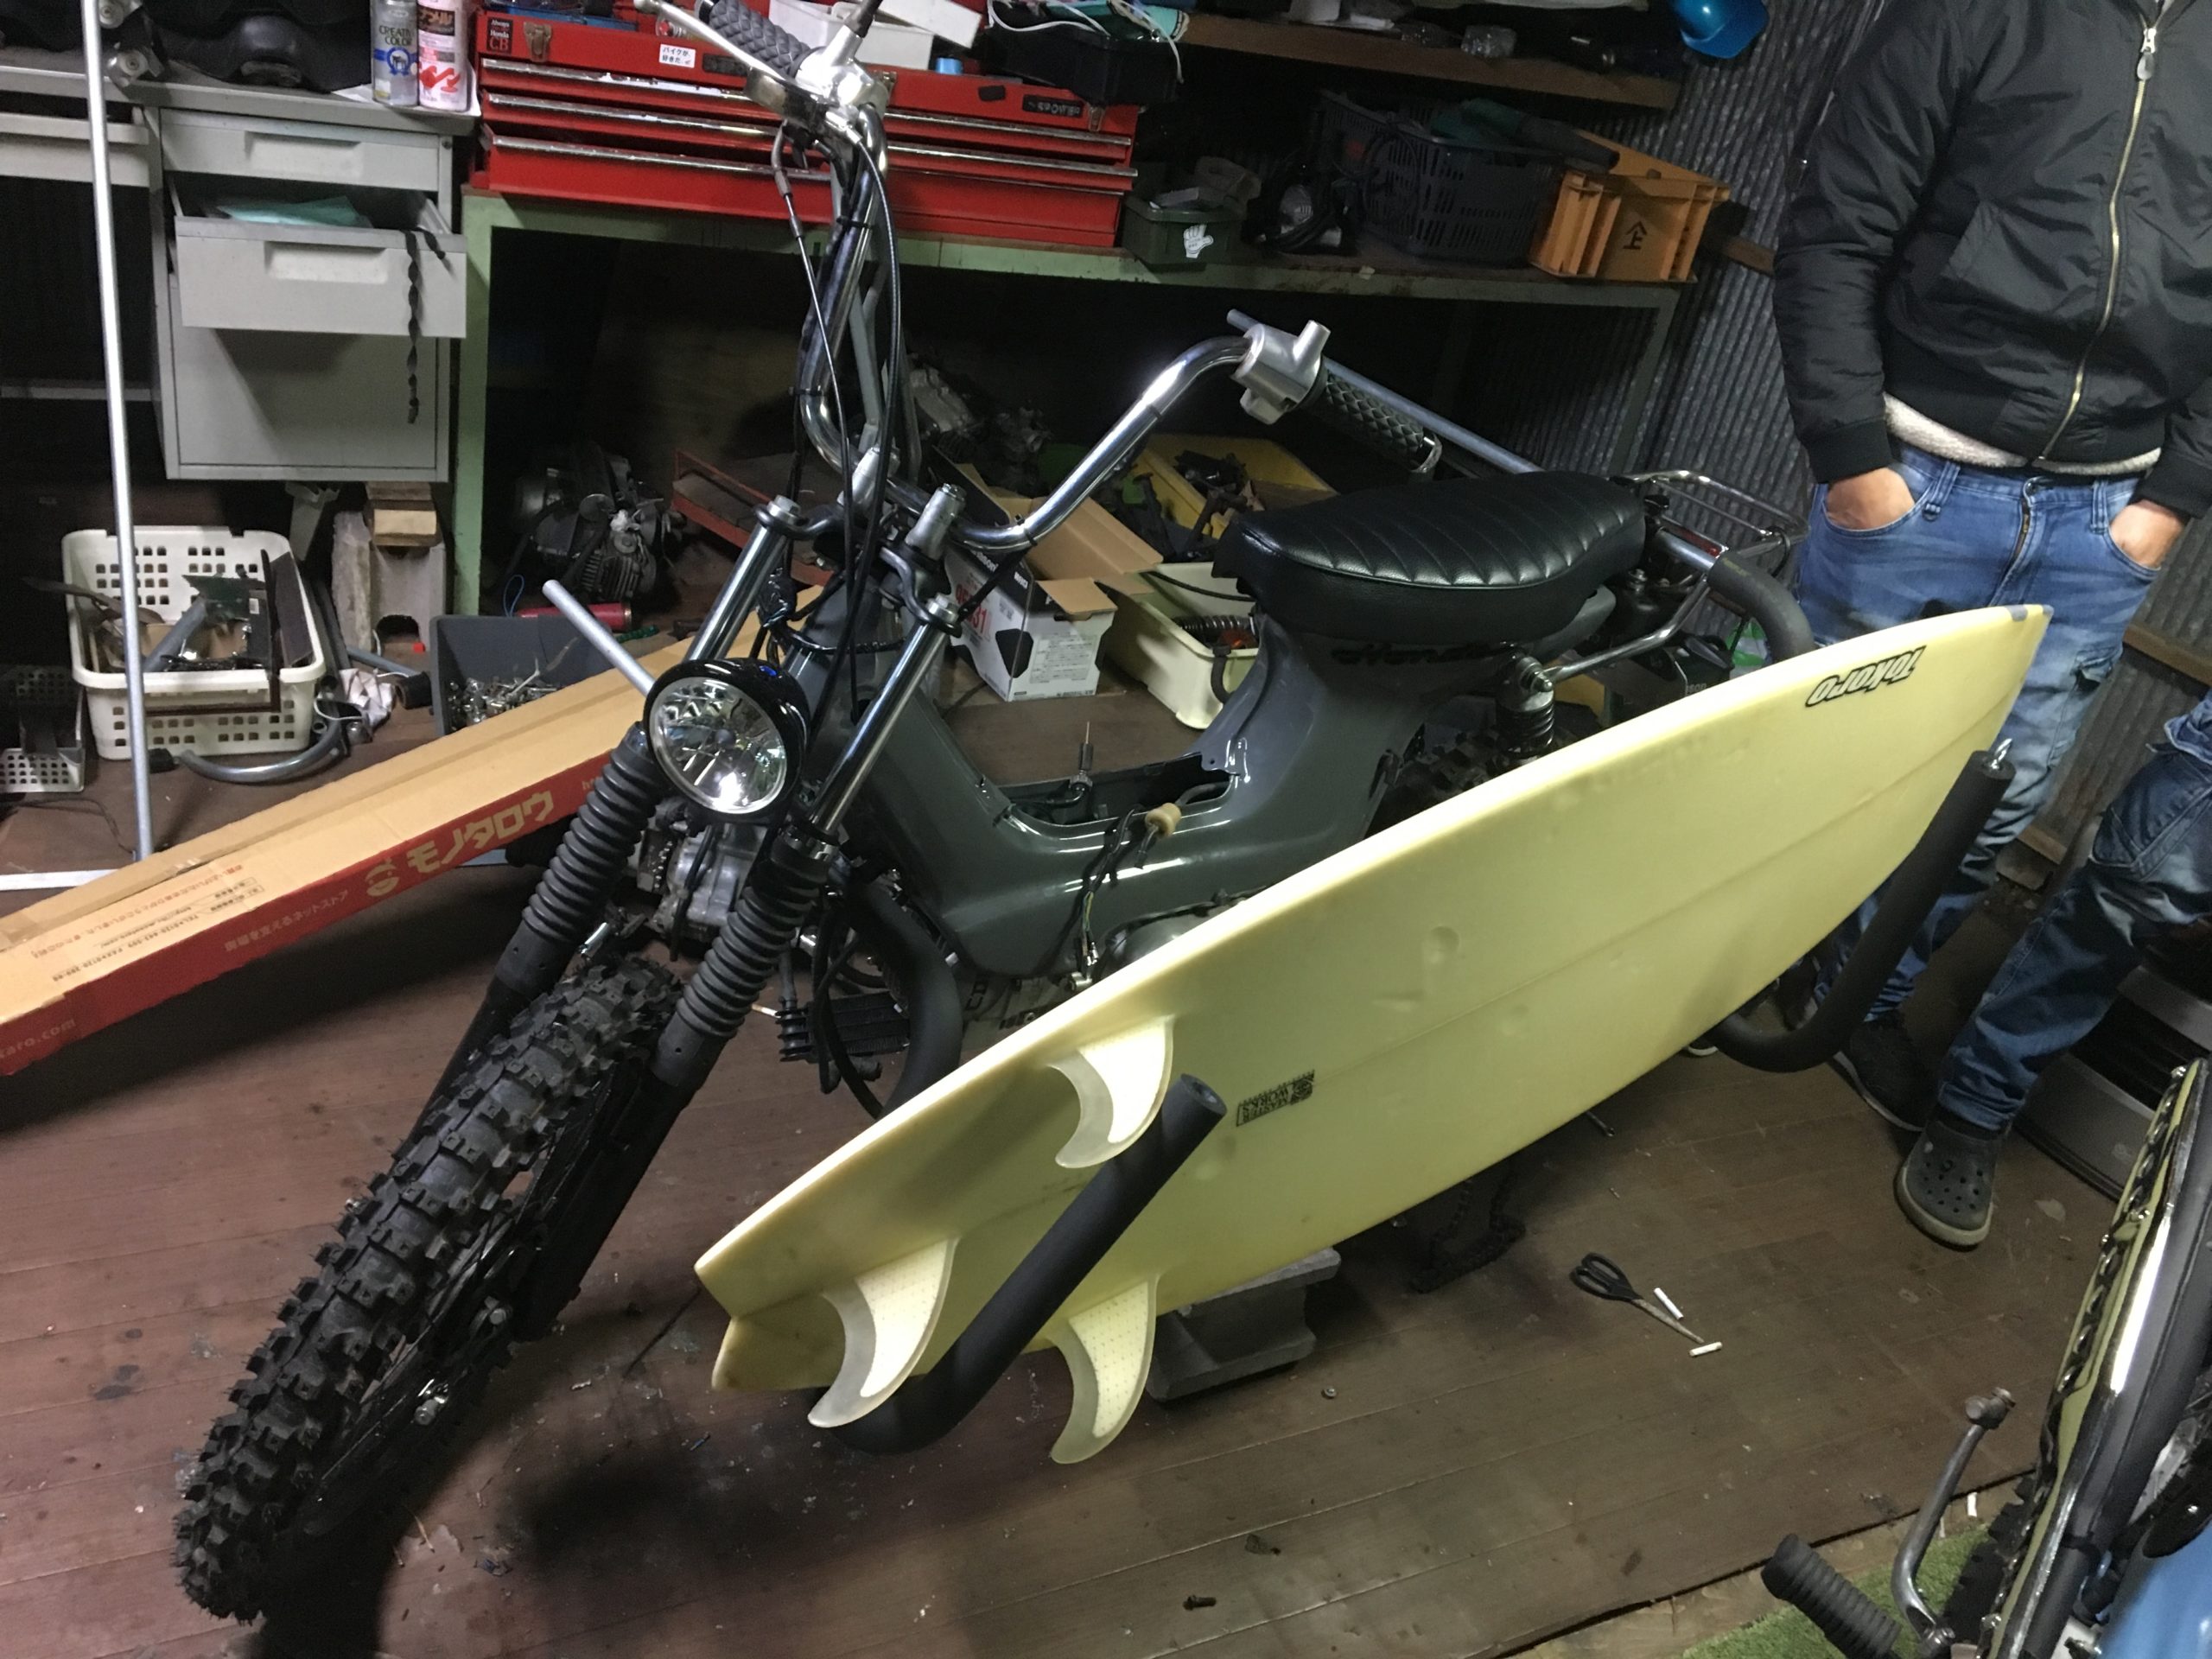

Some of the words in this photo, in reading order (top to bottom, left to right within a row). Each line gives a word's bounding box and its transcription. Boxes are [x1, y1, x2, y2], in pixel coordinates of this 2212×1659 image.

[490, 29, 510, 39] Honda
[489, 37, 509, 50] CB
[406, 790, 554, 874] モノタロウ
